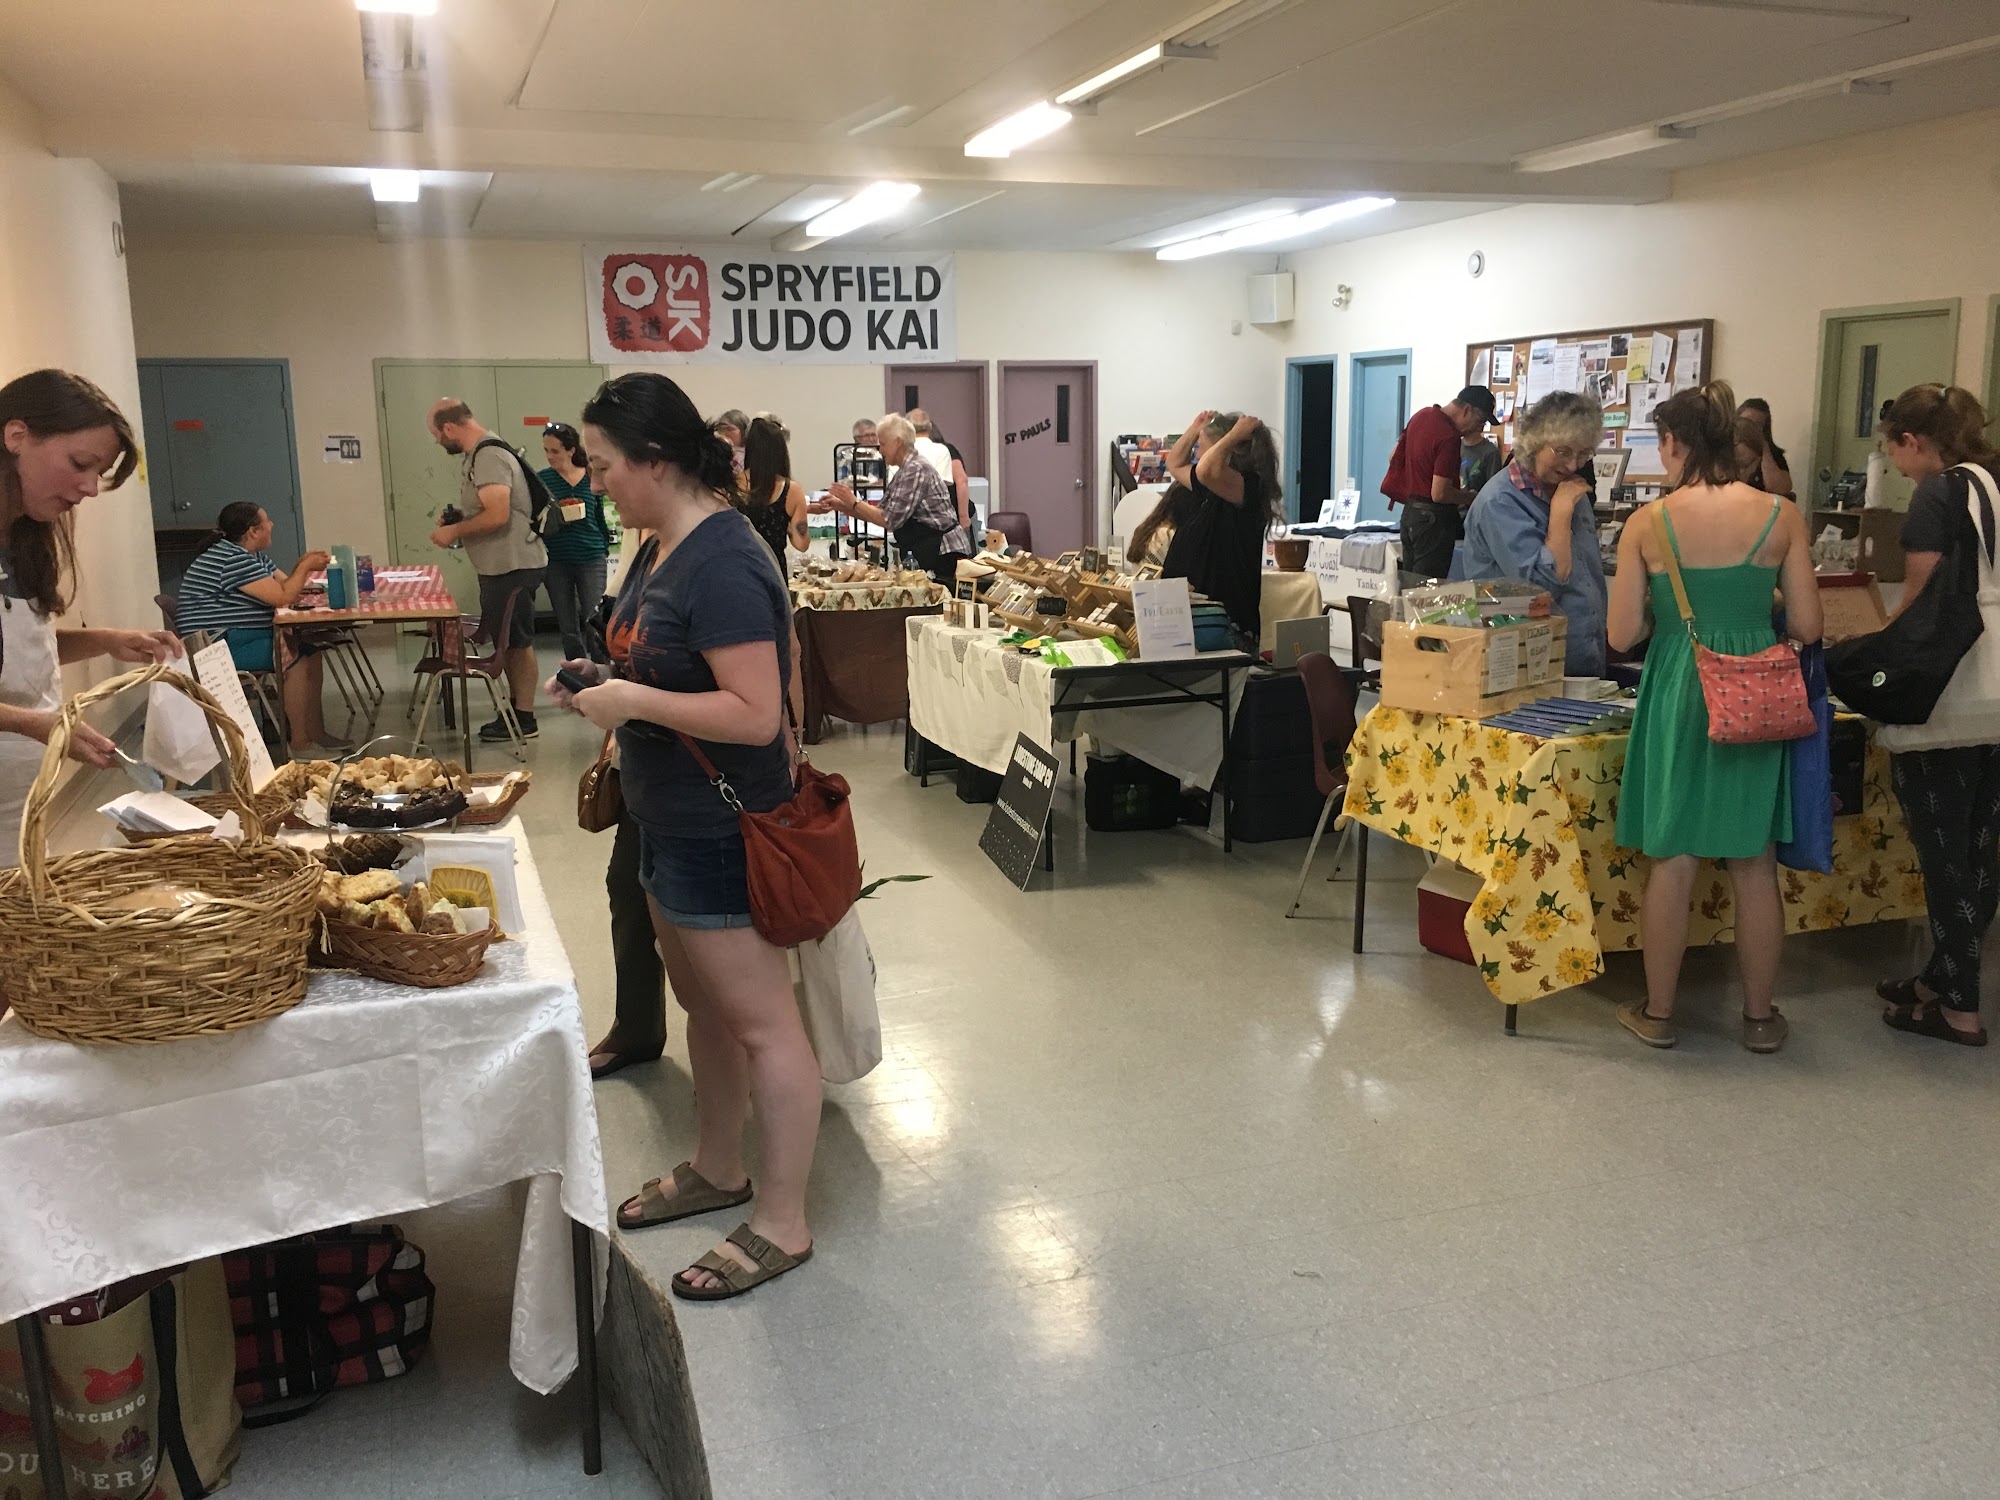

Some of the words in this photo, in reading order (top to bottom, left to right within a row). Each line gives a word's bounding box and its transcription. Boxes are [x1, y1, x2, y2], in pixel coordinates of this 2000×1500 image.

[721, 262, 942, 303] SPRYFIELD
[721, 308, 851, 352] JUDO
[867, 308, 939, 351] KAI
[1004, 432, 1017, 445] ST
[1020, 418, 1051, 441] PAULS
[1356, 578, 1378, 590] Tanks
